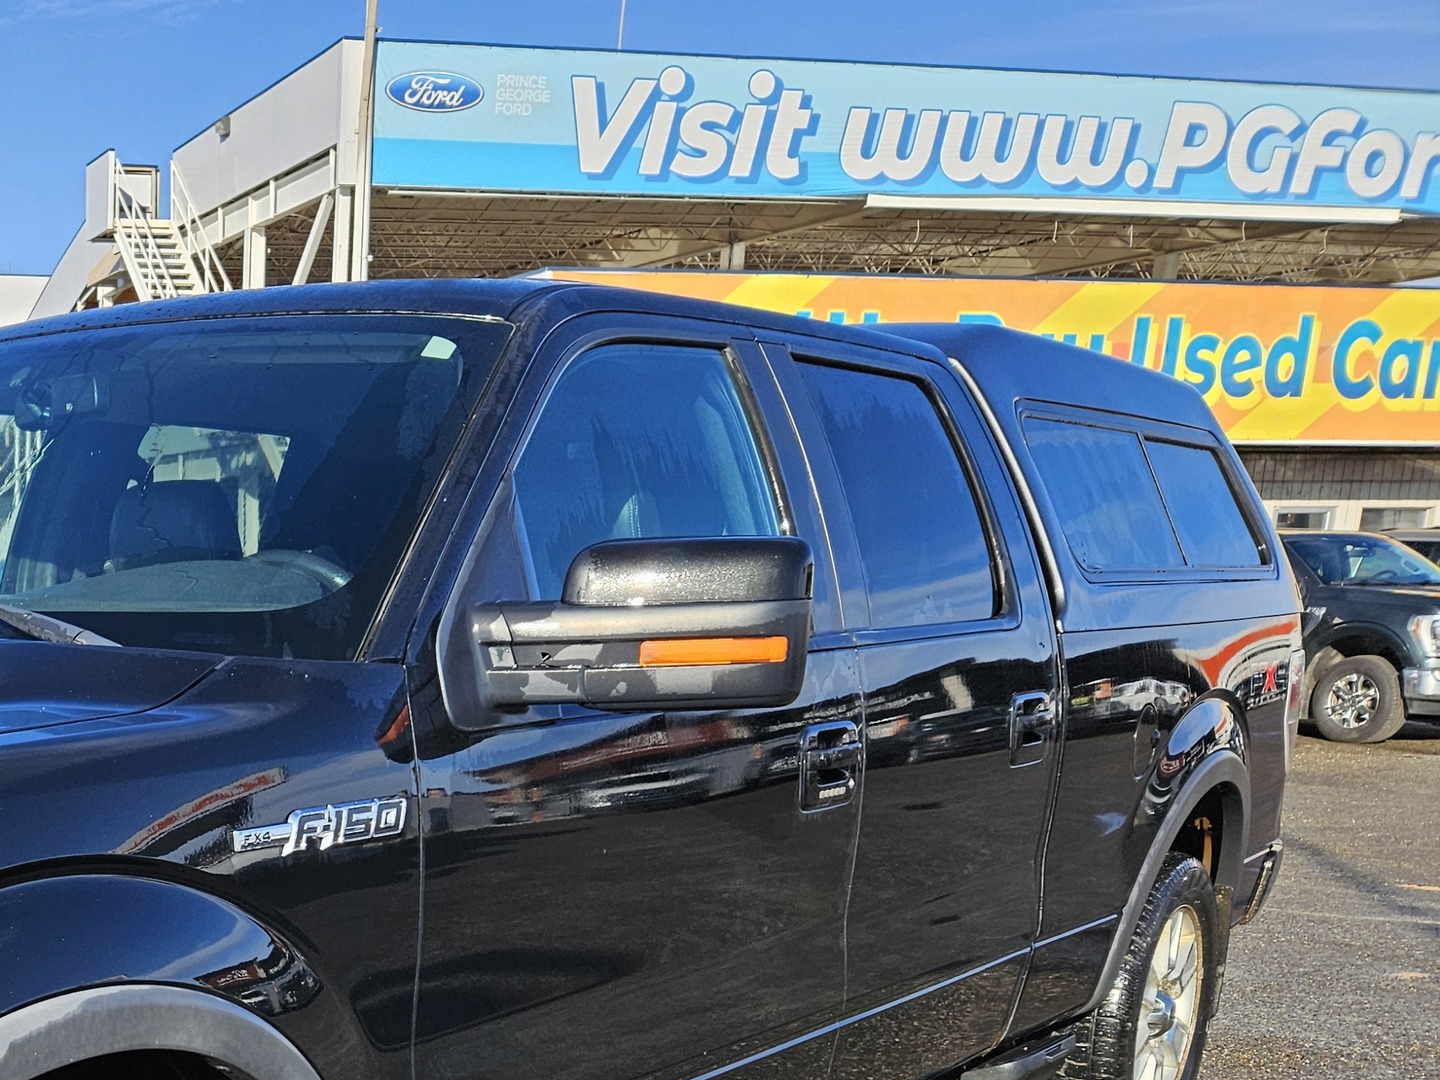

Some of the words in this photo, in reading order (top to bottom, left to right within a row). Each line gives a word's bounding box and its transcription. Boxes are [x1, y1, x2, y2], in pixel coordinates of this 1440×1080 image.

[496, 74, 548, 89] PRINCE
[404, 75, 466, 107] Ford
[496, 88, 552, 103] GEORGE
[494, 102, 533, 117] FORD
[571, 65, 814, 180] Visit
[1129, 314, 1316, 398] Used
[243, 831, 271, 846] FX4
